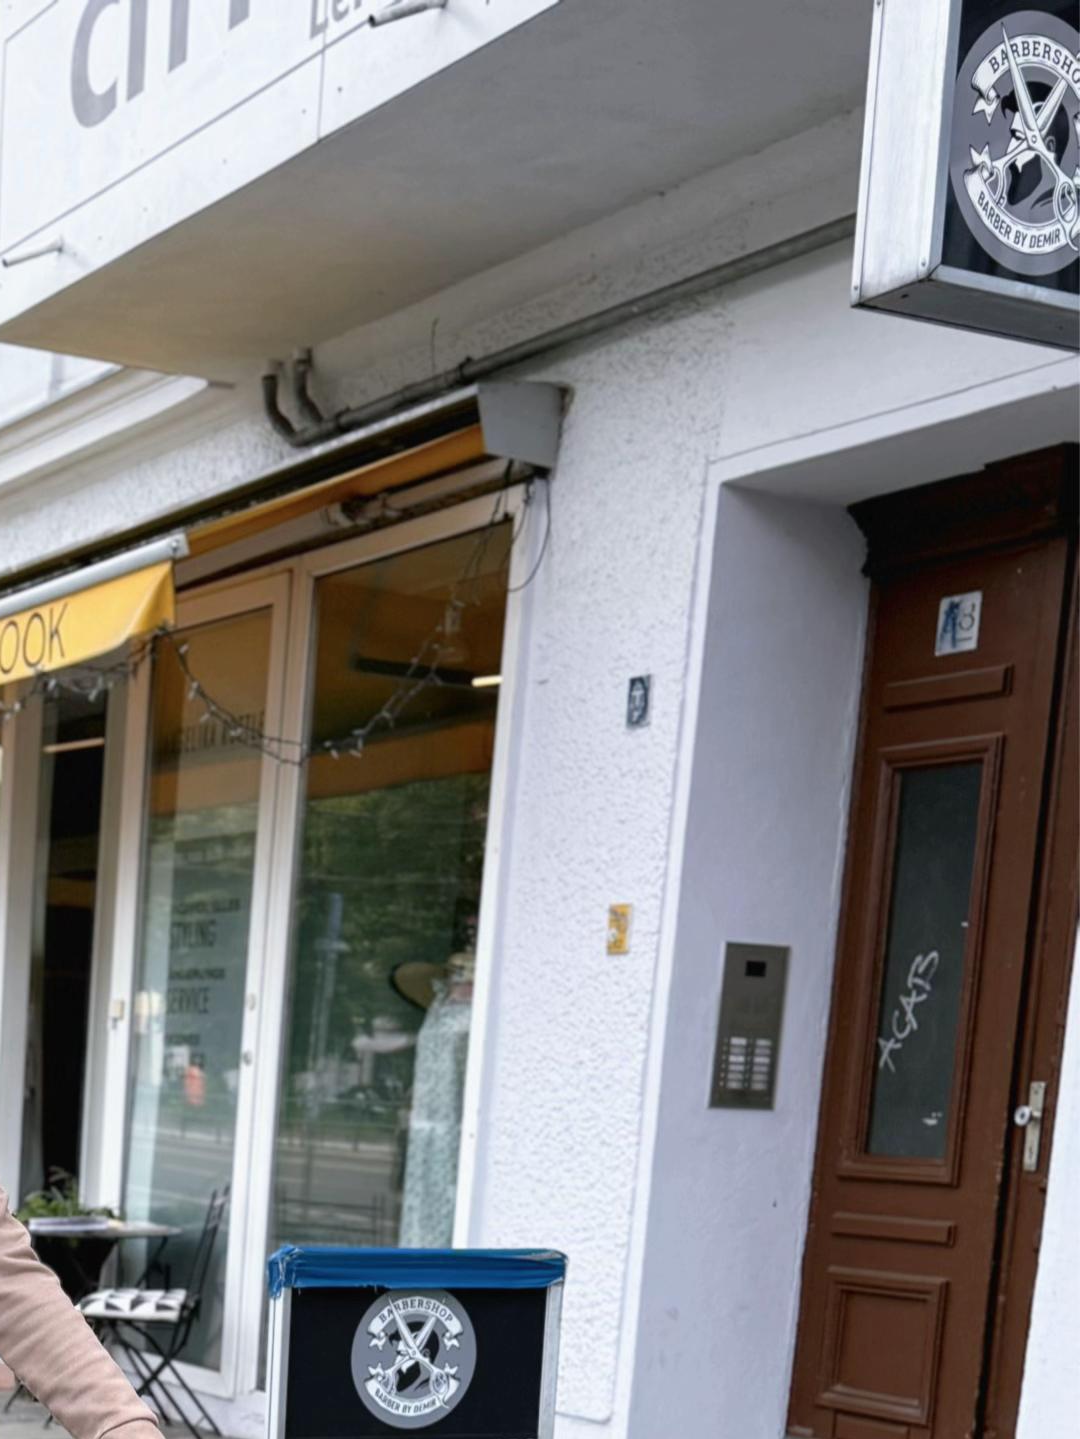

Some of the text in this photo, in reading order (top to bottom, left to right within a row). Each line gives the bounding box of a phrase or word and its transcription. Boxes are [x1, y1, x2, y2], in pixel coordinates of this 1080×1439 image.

[977, 191, 1061, 249] BARBER BY DEMIR
[379, 1298, 453, 1324] BARBERSHOP
[375, 1388, 437, 1414] BARBER BY DEMIR
